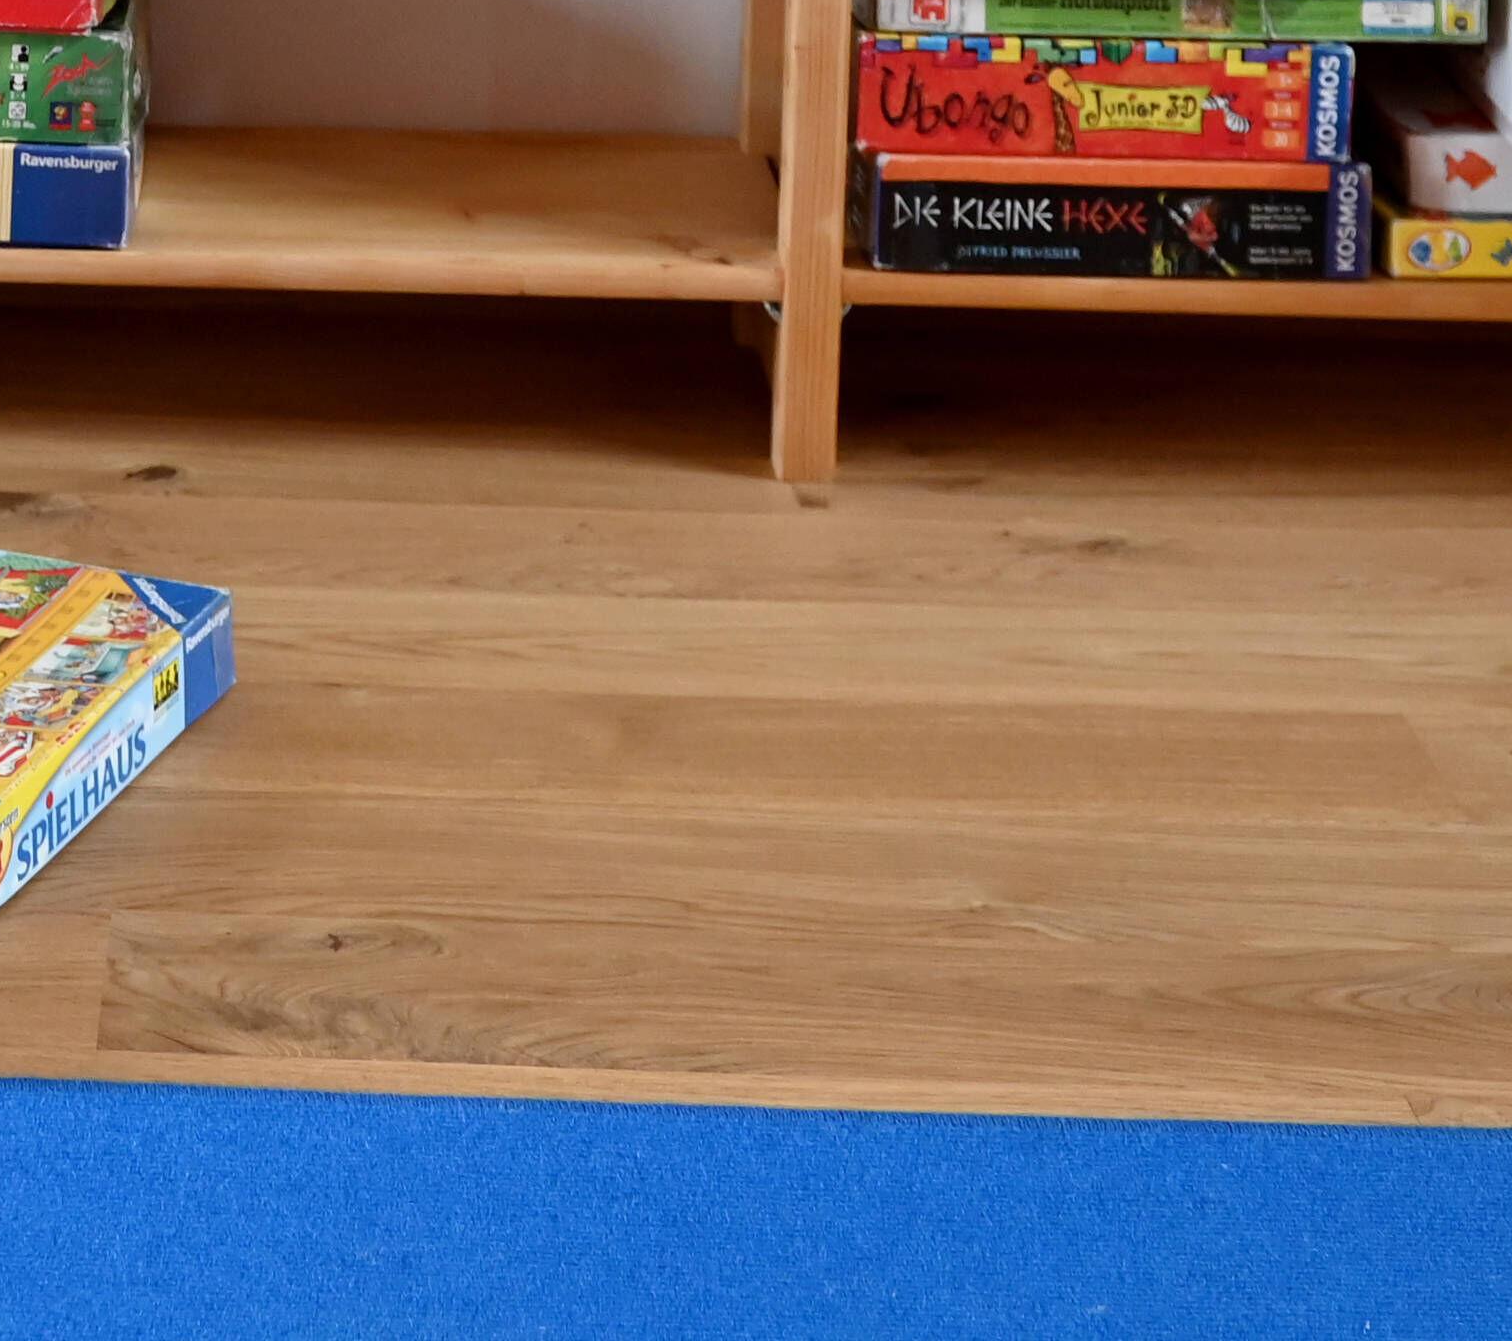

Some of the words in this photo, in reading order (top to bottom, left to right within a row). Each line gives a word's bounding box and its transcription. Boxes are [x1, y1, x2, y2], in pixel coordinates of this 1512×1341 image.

[893, 193, 941, 229] DIE
[953, 196, 1053, 232] KLEINE
[1062, 200, 1146, 234] HEXE
[17, 734, 147, 879] SPIELHAUS
